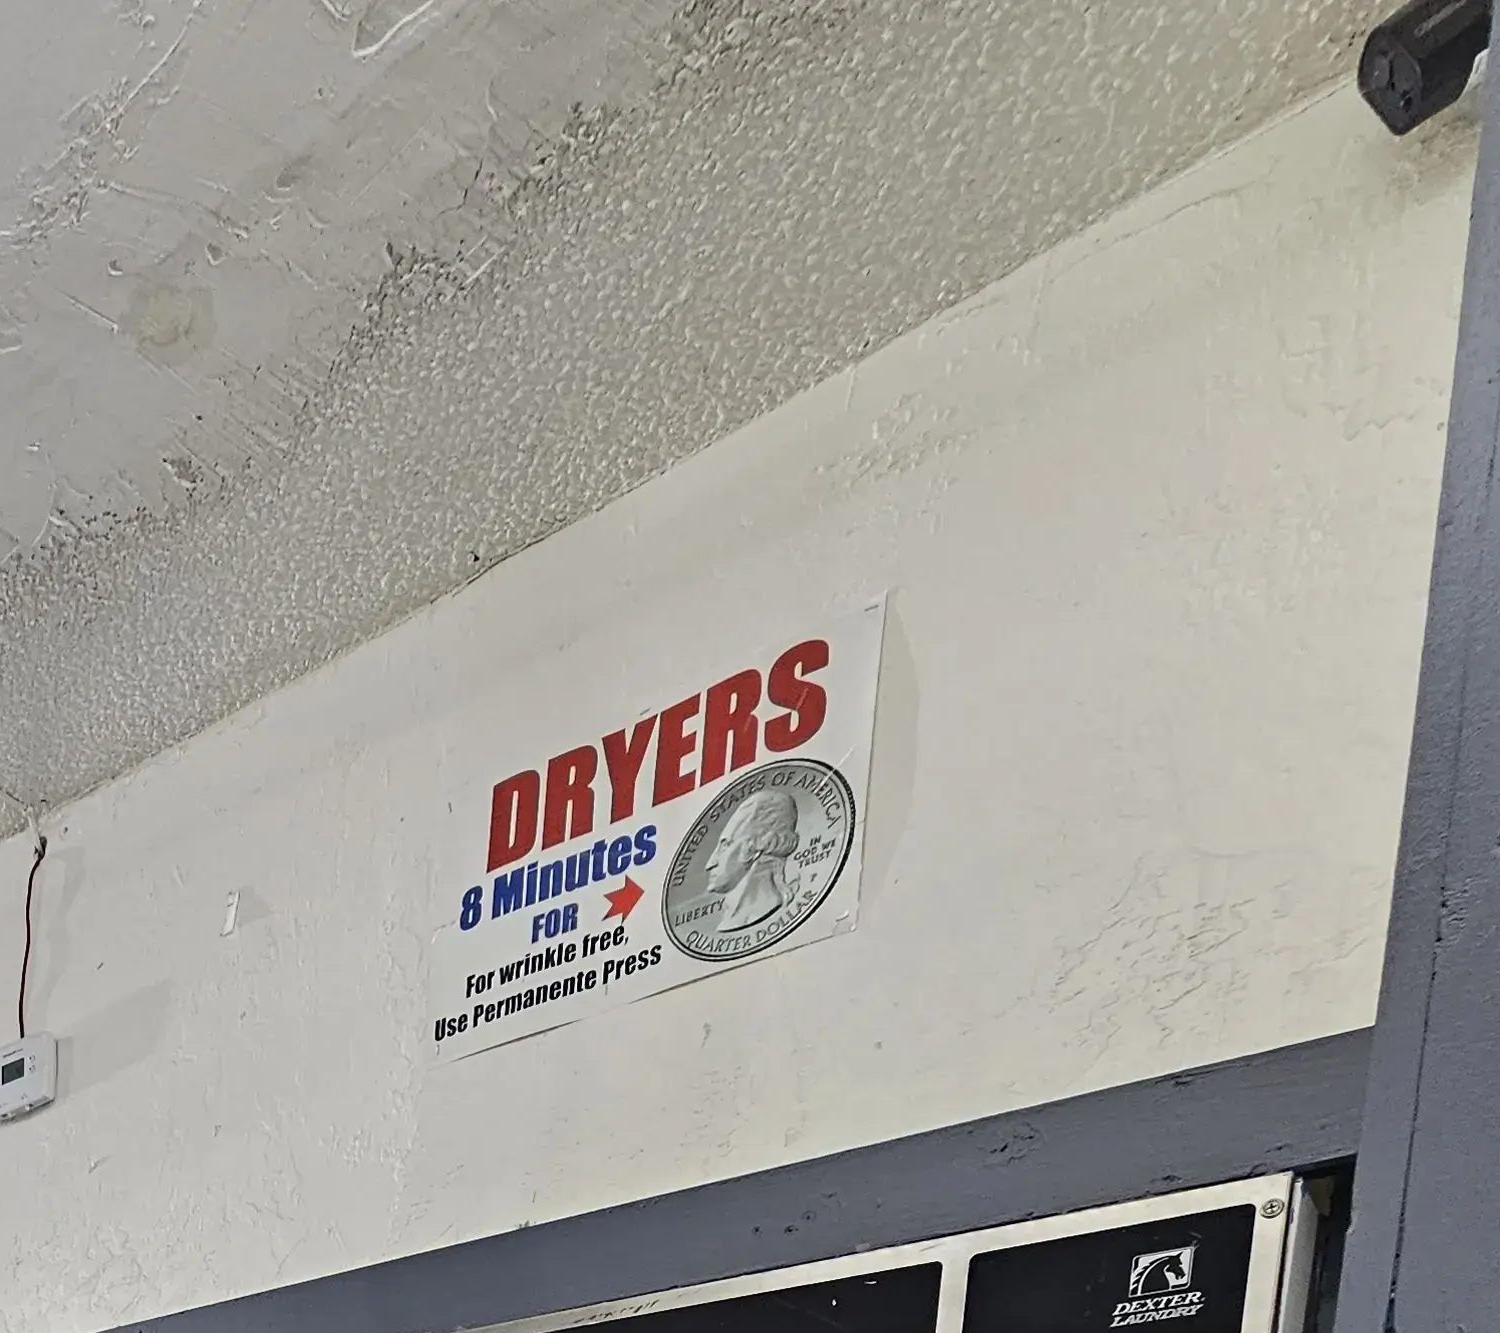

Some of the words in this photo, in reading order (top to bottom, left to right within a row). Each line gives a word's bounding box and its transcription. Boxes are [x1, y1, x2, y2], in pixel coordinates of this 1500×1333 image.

[486, 638, 830, 874] DRYERS
[671, 824, 709, 888] UNITED
[709, 774, 766, 823] STATES
[771, 771, 796, 787] OF
[793, 846, 817, 862] GOD
[821, 838, 836, 852] WE
[809, 835, 822, 847] IN
[459, 885, 484, 932] 8
[491, 824, 657, 920] Minutes
[799, 850, 832, 869] TRUST
[531, 902, 579, 944] FOR
[674, 897, 726, 927] LIBERTY
[686, 930, 752, 953] QUARTER
[755, 890, 818, 942] DOLLAR
[466, 969, 495, 998] For
[499, 941, 577, 986] wrinkle
[581, 925, 629, 959] free,
[434, 1012, 468, 1042] Use
[473, 969, 597, 1028] Permanente
[602, 944, 662, 985] Press
[1109, 1304, 1204, 1328] LAUNDRY
[1111, 1291, 1203, 1316] DEXTER
